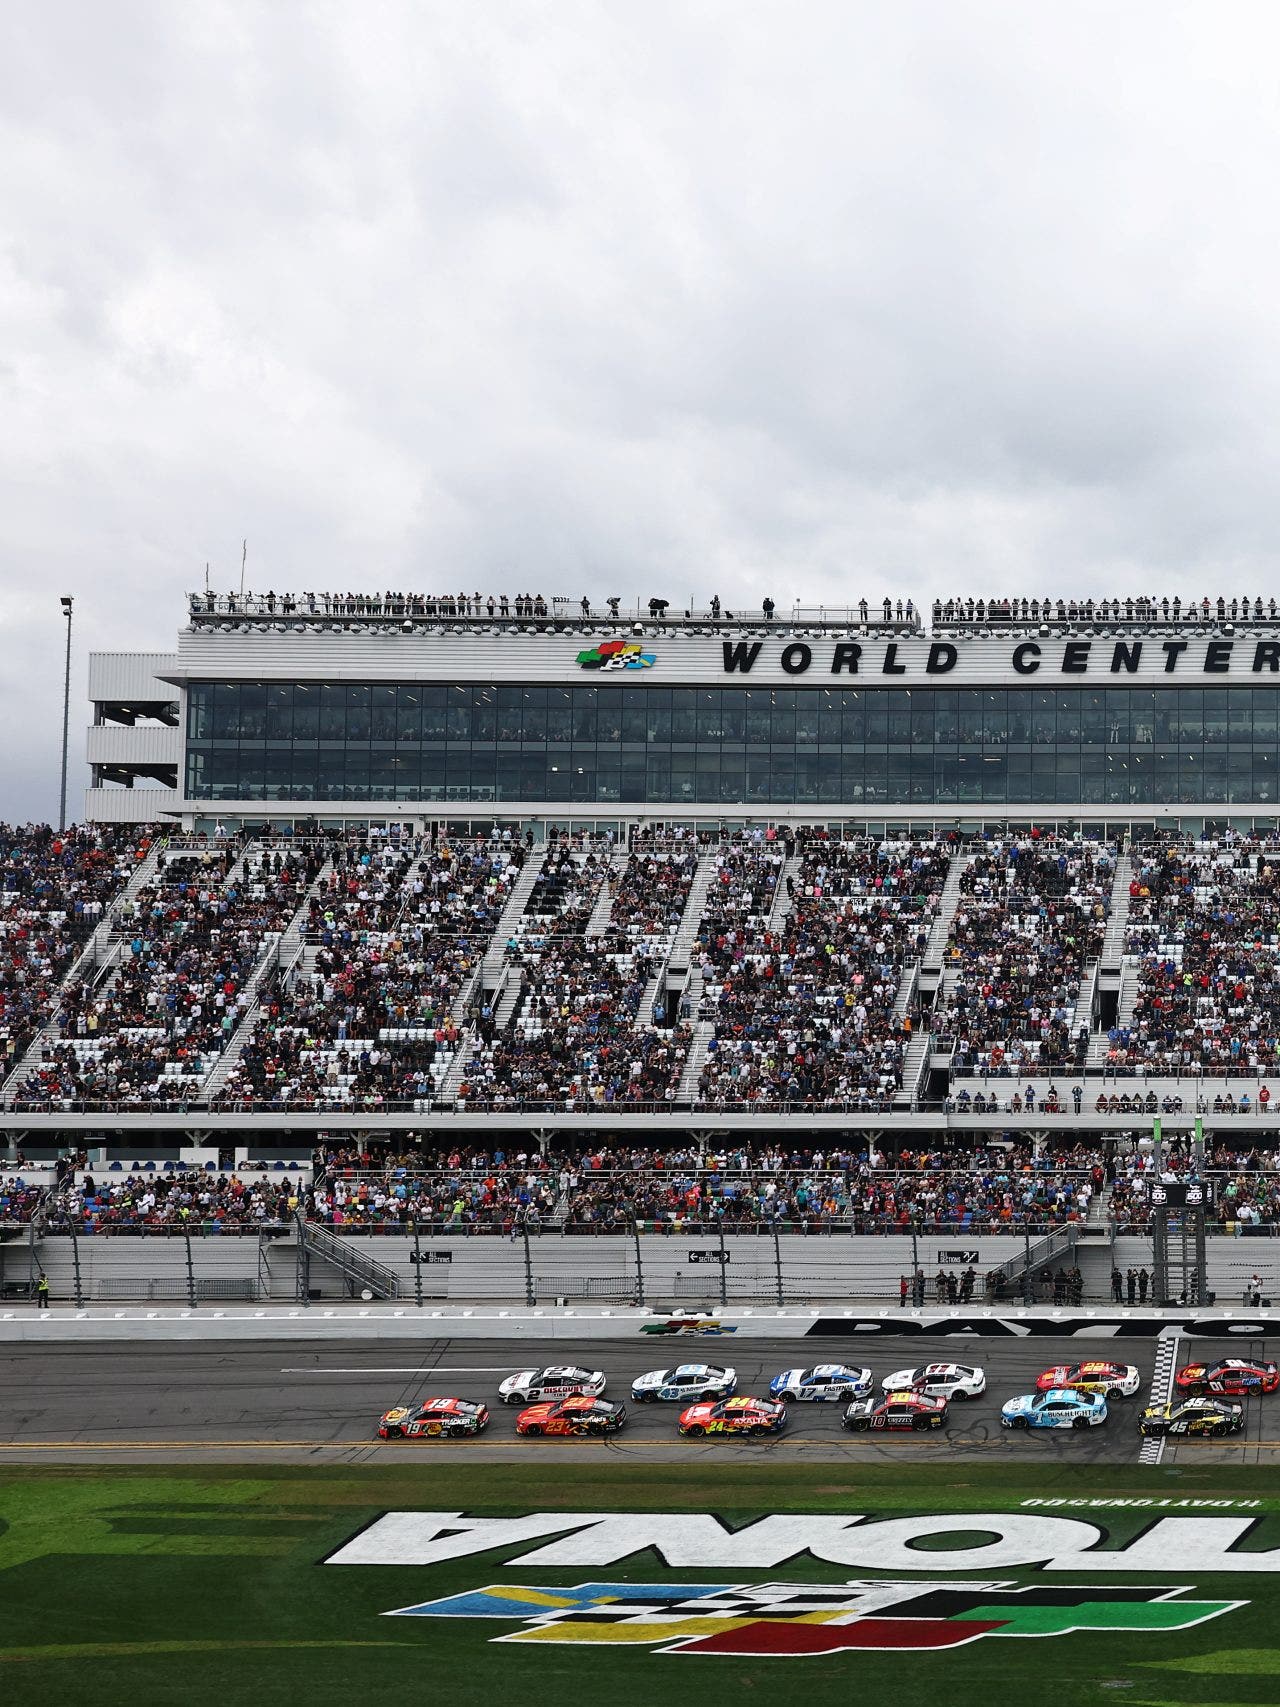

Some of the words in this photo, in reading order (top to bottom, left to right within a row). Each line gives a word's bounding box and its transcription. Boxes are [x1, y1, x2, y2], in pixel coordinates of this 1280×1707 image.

[722, 641, 958, 674] WORLD
[1186, 1192, 1203, 1200] 500
[1083, 1362, 1105, 1372] 22
[543, 1386, 584, 1394] DISCOUNT
[1107, 1381, 1125, 1389] Shell
[1208, 1381, 1225, 1392] 01
[526, 1389, 541, 1400] 2
[800, 1388, 817, 1398] 17
[429, 1398, 454, 1409] 19
[564, 1397, 588, 1407] 23
[726, 1398, 750, 1407] 24
[1183, 1397, 1206, 1408] 45
[441, 1418, 471, 1426] TRACKER
[733, 1417, 768, 1425] AXALTA
[870, 1415, 886, 1427] 10
[406, 1422, 420, 1434] 19
[545, 1421, 564, 1432] 23
[709, 1421, 725, 1432] 24
[1168, 1421, 1189, 1433] 45
[1020, 1498, 1264, 1508] #DAYTONA500
